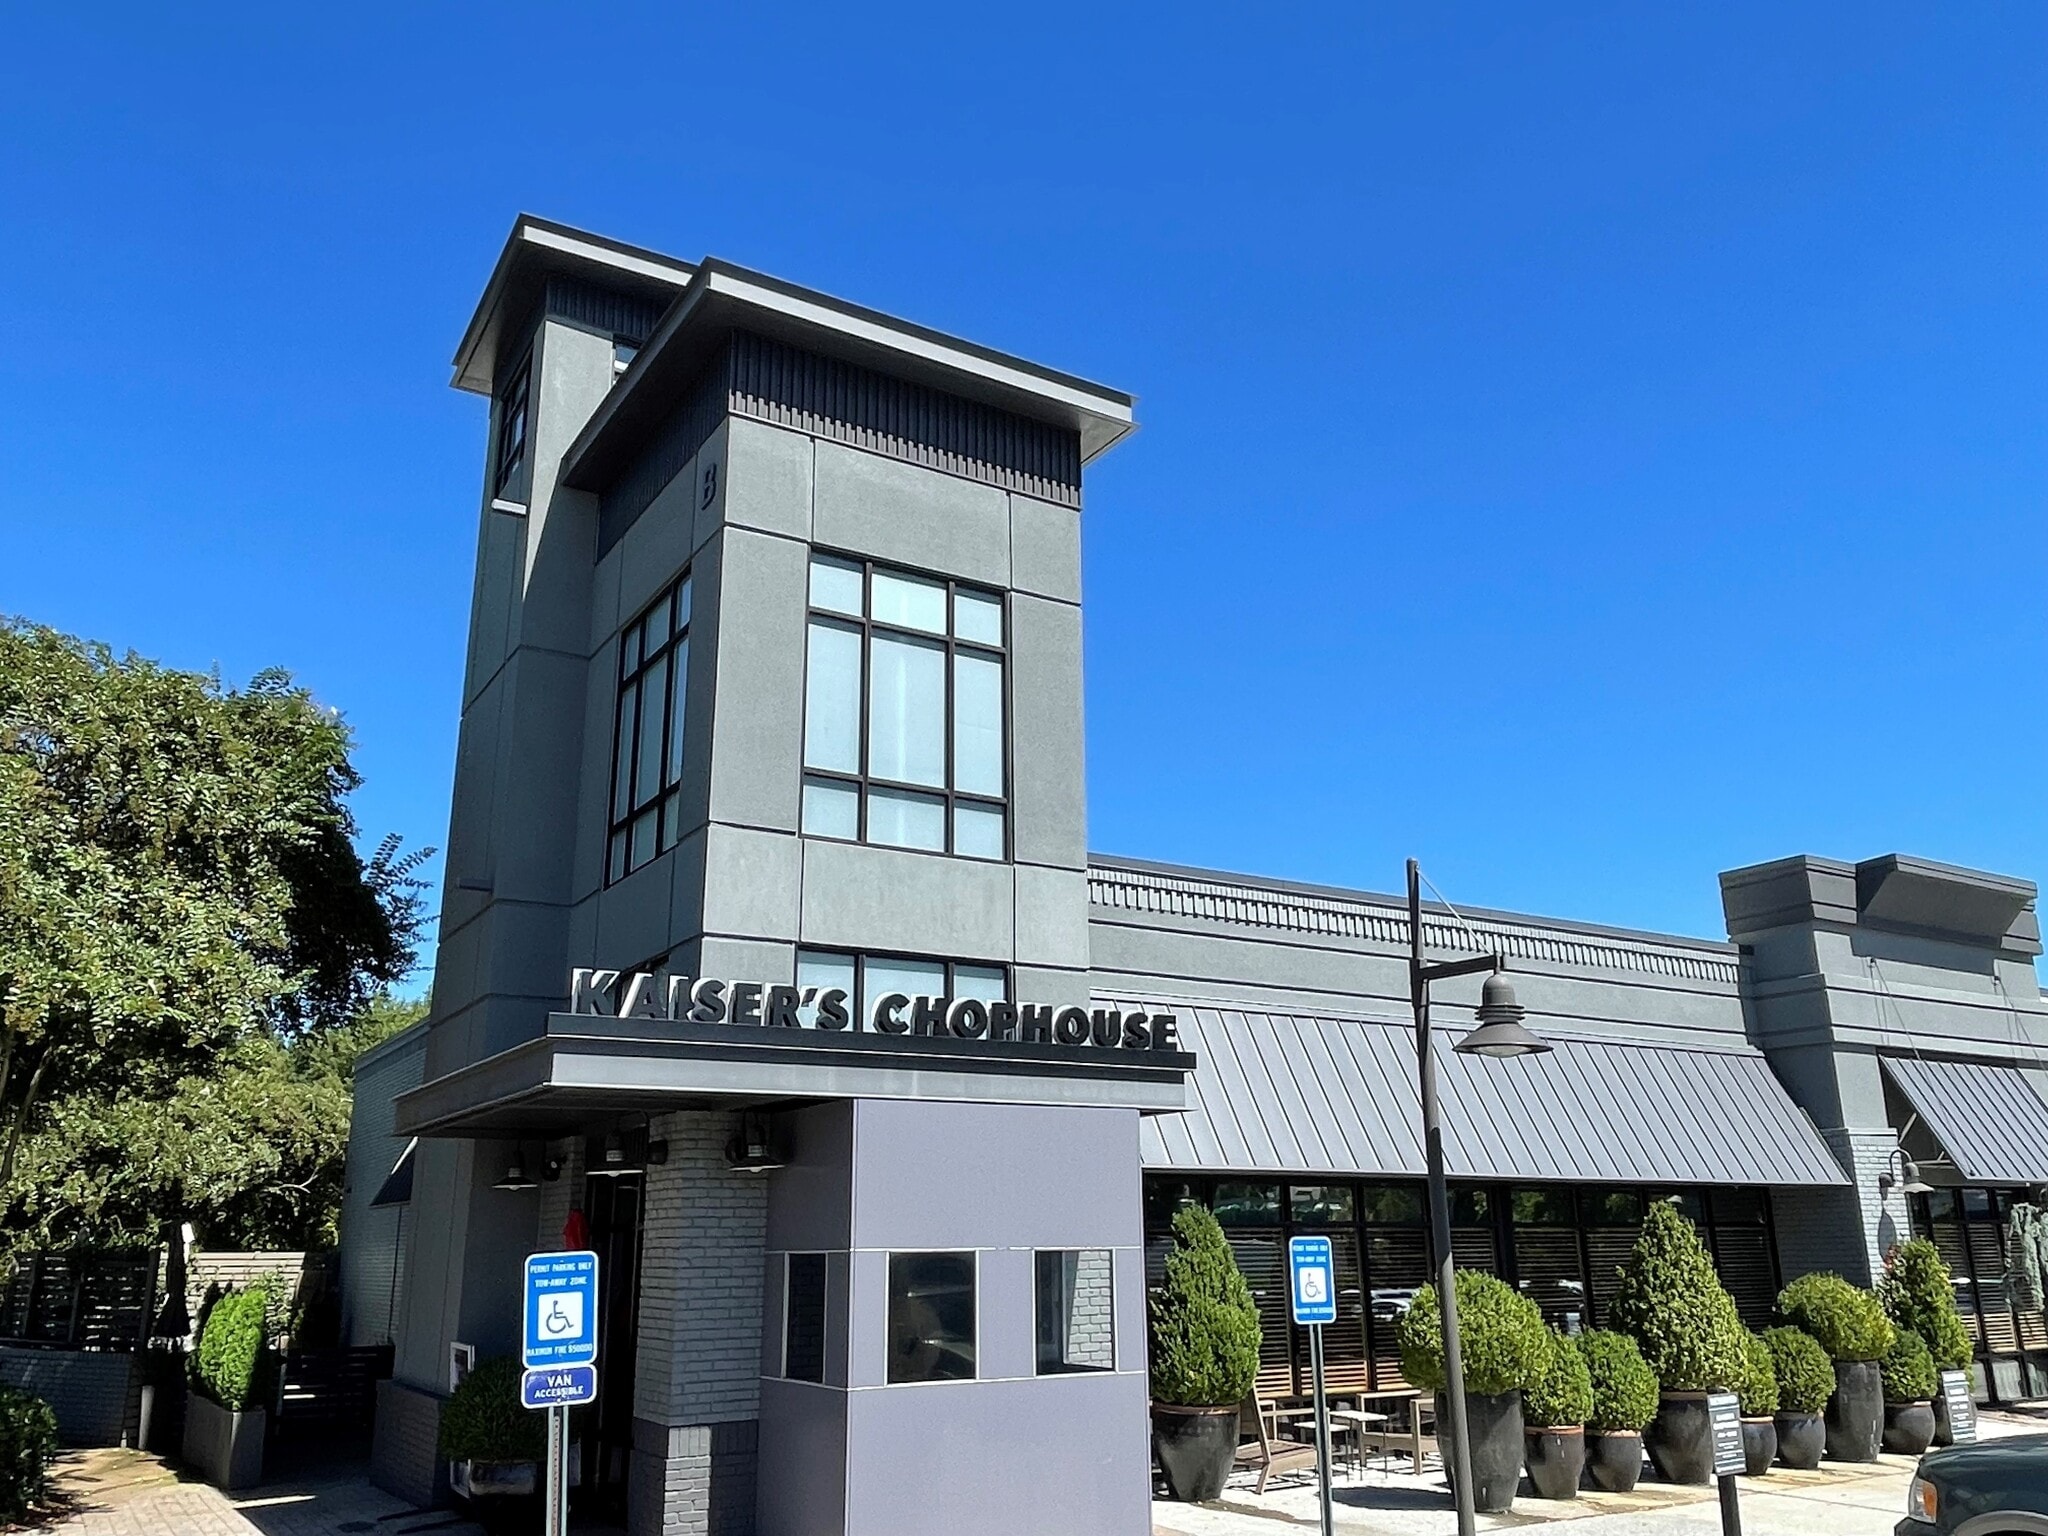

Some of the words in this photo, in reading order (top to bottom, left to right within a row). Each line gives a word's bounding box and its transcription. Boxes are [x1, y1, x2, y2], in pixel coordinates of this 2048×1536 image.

[571, 967, 850, 1032] KAISER'S
[872, 992, 1179, 1051] CHOPHOUSE
[547, 1374, 572, 1388] VAN
[534, 1385, 584, 1399] ACCESSIBLE
